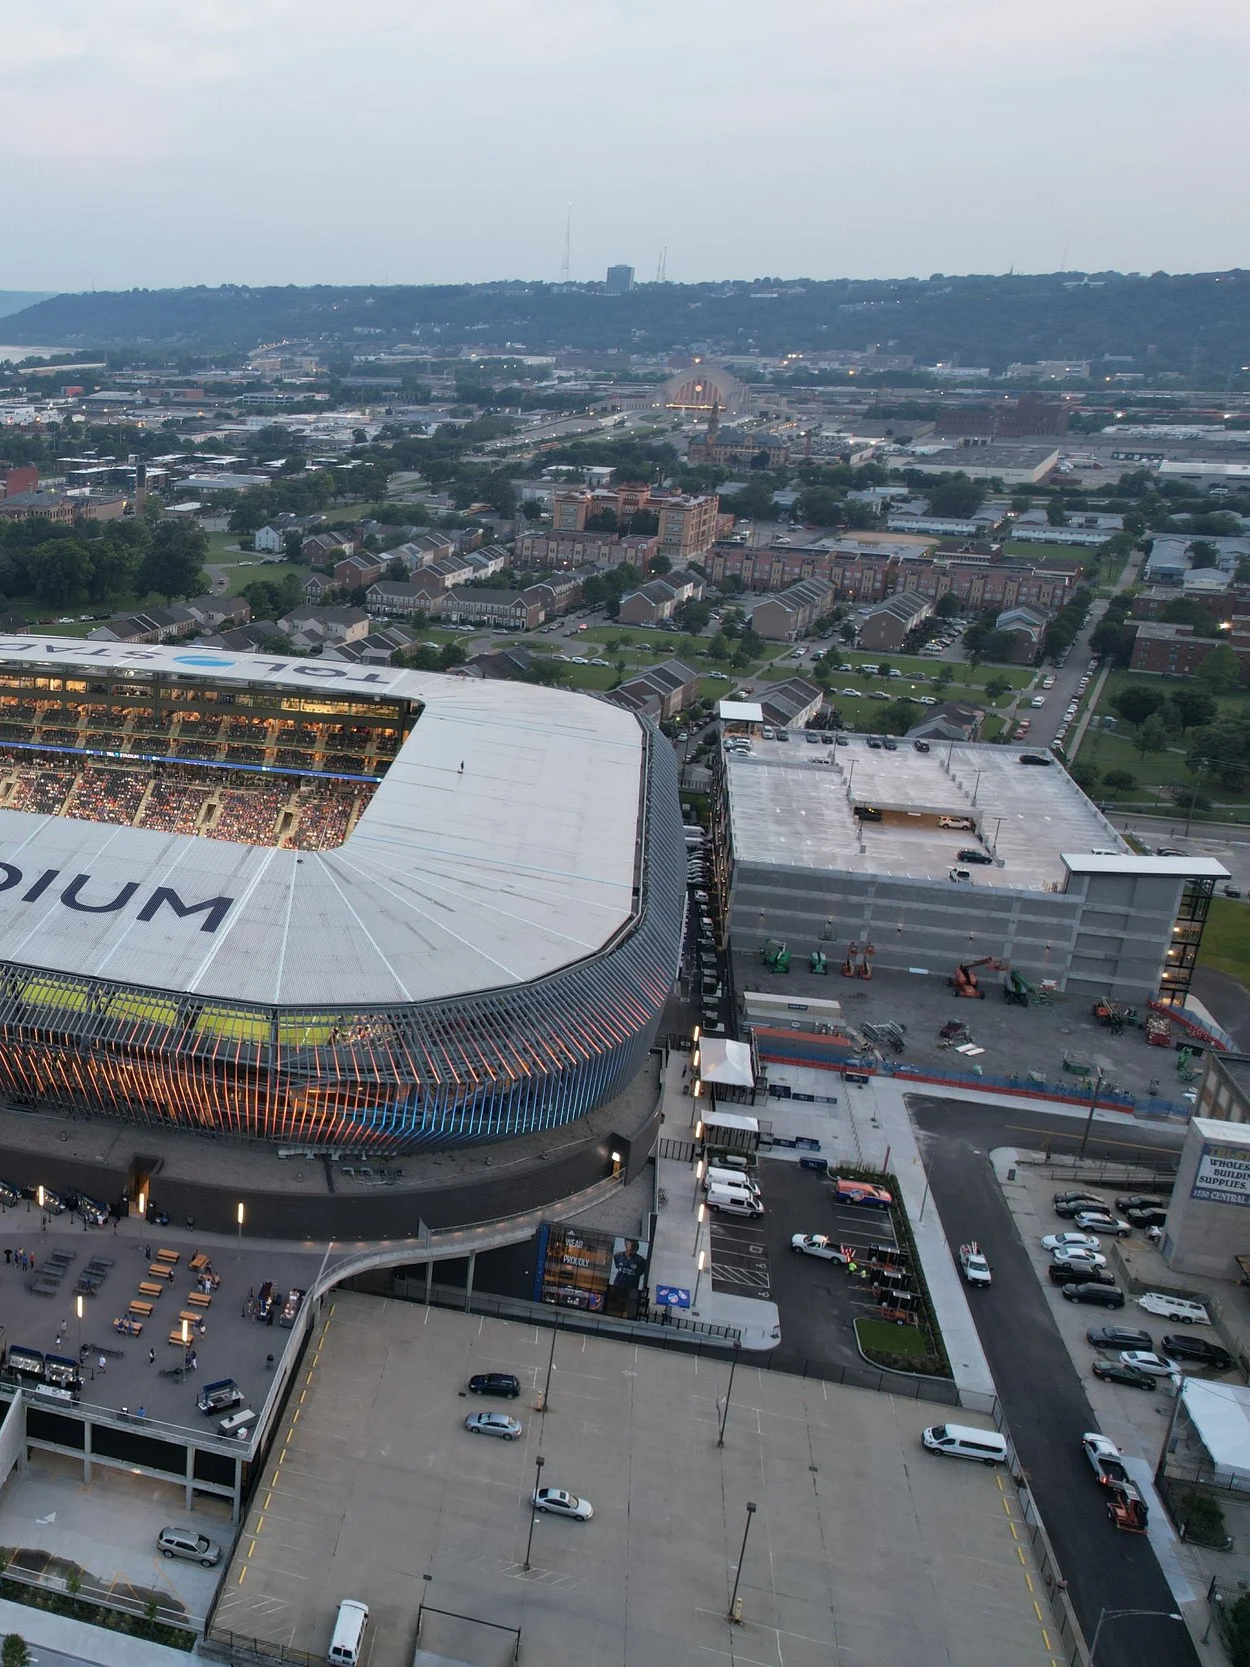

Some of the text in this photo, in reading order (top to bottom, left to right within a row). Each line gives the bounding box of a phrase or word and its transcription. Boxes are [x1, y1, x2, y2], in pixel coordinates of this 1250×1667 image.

[253, 661, 391, 685] TQL
[1211, 1191, 1246, 1204] CENTRAL
[565, 1238, 584, 1249] WEAR
[562, 1254, 590, 1267] PROUDLY
